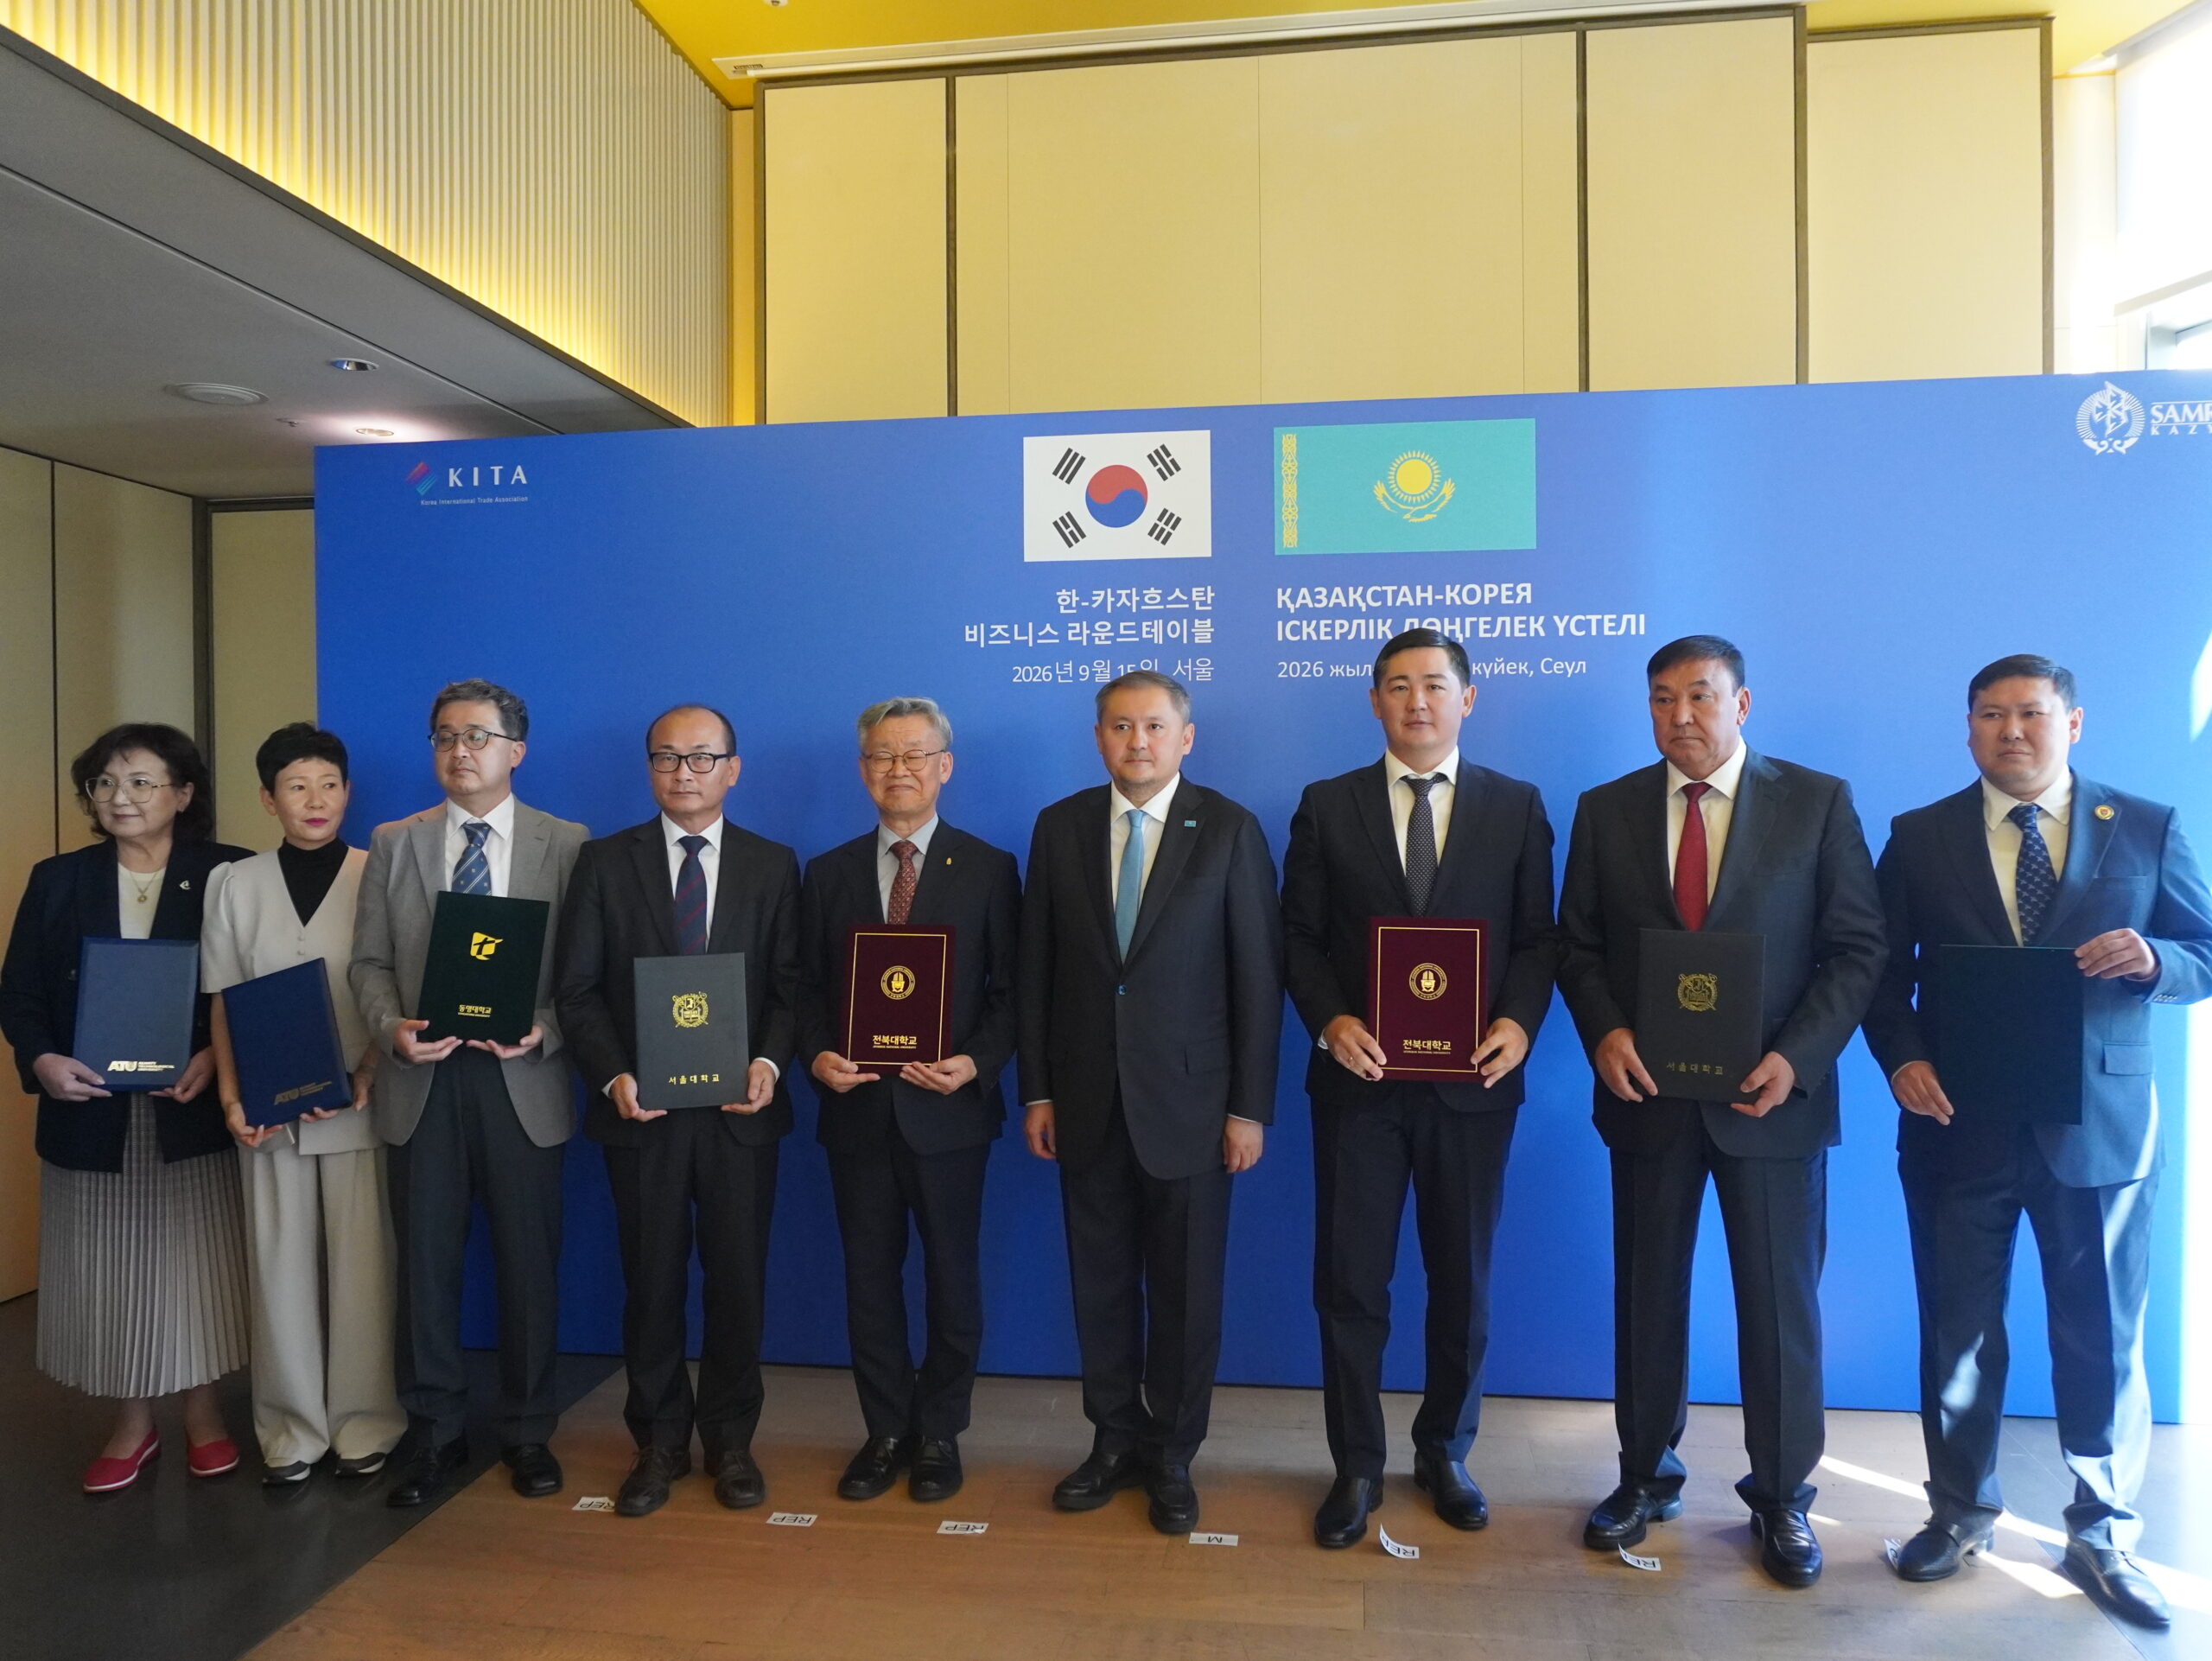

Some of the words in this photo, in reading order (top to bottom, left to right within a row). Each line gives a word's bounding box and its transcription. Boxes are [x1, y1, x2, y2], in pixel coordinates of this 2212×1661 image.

[448, 465, 528, 487] KITA
[495, 494, 529, 503] Association
[1056, 585, 1216, 614] 한-카자흐스탄
[1277, 582, 1532, 614] ҚАЗАҚСТАН-КОРЕЯ
[965, 620, 1060, 648] 비즈니스
[1067, 618, 1216, 646] 라운드테이블
[1277, 618, 1393, 641] ІСКЕРЛІК
[1553, 614, 1645, 637] ҮСТЕЛІ
[1012, 659, 1074, 683] 2026년
[1078, 659, 1111, 683] 9월
[1173, 657, 1215, 681] 서울
[1278, 661, 1324, 678] 2026
[1329, 664, 1374, 677] жыл
[1471, 658, 1535, 681] күйек,
[1540, 657, 1587, 678] Сеул
[872, 1034, 918, 1046] 전북대학교
[1402, 1039, 1452, 1051] 전북대학교
[107, 1060, 138, 1072] ATU
[1666, 1061, 1724, 1076] 서울대학교
[668, 1073, 720, 1085] 서울대학교
[773, 1515, 811, 1524] REP
